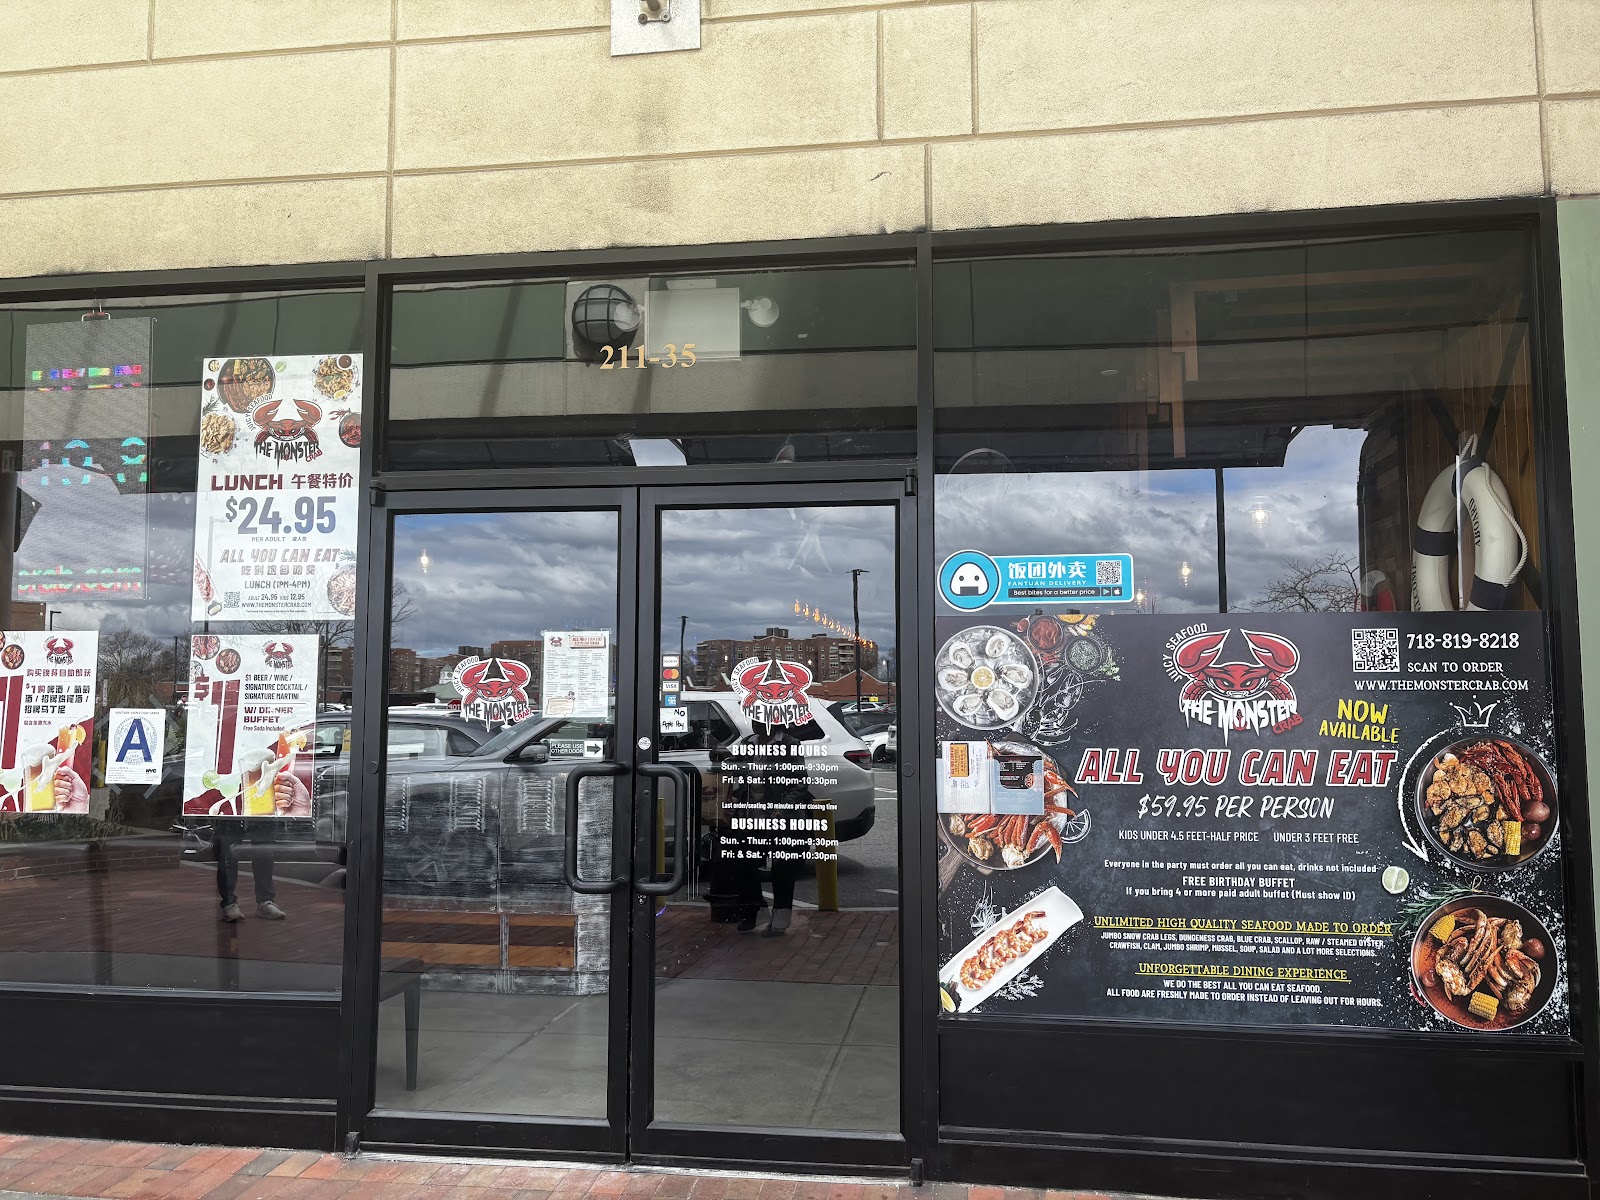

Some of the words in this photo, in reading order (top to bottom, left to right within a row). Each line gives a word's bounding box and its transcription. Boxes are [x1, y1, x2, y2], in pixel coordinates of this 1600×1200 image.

[599, 344, 696, 369] 211-35
[248, 393, 272, 411] SEAFOOD
[254, 440, 273, 459] THE
[272, 440, 320, 468] MONSTER
[211, 474, 283, 491] LUNCH
[291, 473, 353, 489] 午餐特价
[225, 496, 336, 534] $24.95
[1468, 498, 1481, 547] ABOARD
[220, 549, 244, 563] ALL
[250, 549, 278, 563] YOU
[280, 549, 310, 562] CAN
[314, 548, 340, 562] EAT
[1008, 561, 1086, 579] 饭团外卖
[245, 581, 271, 589] LUNCH
[1166, 623, 1208, 650] SEAFOOD
[1407, 633, 1519, 649] 718-819-8218
[455, 657, 479, 674] SEAFOOD
[734, 658, 758, 675] SEAFOOD
[1162, 654, 1182, 682] JUICY
[1408, 662, 1437, 672] SCAN
[1442, 662, 1458, 672] TO
[1462, 662, 1503, 674] ORDER
[454, 677, 464, 693] JUICY
[732, 678, 743, 695] JUICY
[1354, 678, 1528, 692] WWW.THEMONSTERCRAB.COM
[464, 703, 481, 719] THE
[482, 702, 527, 728] MONSTER
[674, 709, 685, 717] NO
[743, 705, 763, 721] THE
[762, 704, 809, 730] MONSTER
[1338, 698, 1388, 724] NOW
[662, 721, 673, 730] Apple
[676, 721, 684, 730] Pay
[1181, 699, 1218, 728] THE
[1212, 697, 1298, 746] MONSTER
[1272, 713, 1304, 734] CRAB
[115, 718, 153, 762] A
[1319, 720, 1400, 744] AVAILABLE
[731, 744, 787, 756] BUSINESS
[790, 744, 828, 757] HOURS
[774, 762, 839, 773] 1:00pm-9:30pm
[1074, 748, 1144, 784] ALL
[1156, 748, 1231, 786] YOU
[1238, 749, 1318, 786] CAN
[1326, 749, 1398, 787] EAT
[768, 776, 837, 786] 1:00pm-10:30pm
[733, 802, 766, 810] order/seating
[1138, 794, 1209, 819] $59.95
[1215, 795, 1254, 818] PER
[1260, 795, 1334, 819] PERSON
[732, 818, 786, 830] BUSINESS
[790, 819, 828, 831] HOURS
[720, 836, 739, 844] Sun.
[747, 837, 771, 845] Thur.:
[774, 837, 839, 847] 1:00pm-9:30pm
[1119, 830, 1138, 840] KIDS
[1140, 831, 1168, 840] UNDER
[1171, 831, 1184, 840] 4.5
[1186, 831, 1232, 841] FEET-HALF
[1234, 832, 1259, 841] PRICE
[1273, 832, 1302, 842] UNDER
[1313, 833, 1334, 843] FEET
[1337, 833, 1359, 843] FREE
[768, 851, 837, 861] 1:00pm-10:30pm
[1183, 876, 1206, 886] FREE
[1209, 877, 1255, 887] BIRTHDAY
[1259, 878, 1295, 888] BUFFET
[1093, 916, 1153, 928] UNLIMITED
[1157, 918, 1186, 929] HIGH
[1190, 919, 1237, 930] QUALITY
[1241, 920, 1292, 931] SEAFOOD
[1296, 921, 1329, 932] MADE
[1333, 922, 1348, 932] TO
[1353, 922, 1393, 934] ORDER
[1139, 963, 1229, 976] UNFORGETTABLE
[1233, 966, 1273, 978] DINING
[1278, 968, 1347, 979] EXPERIENCE
